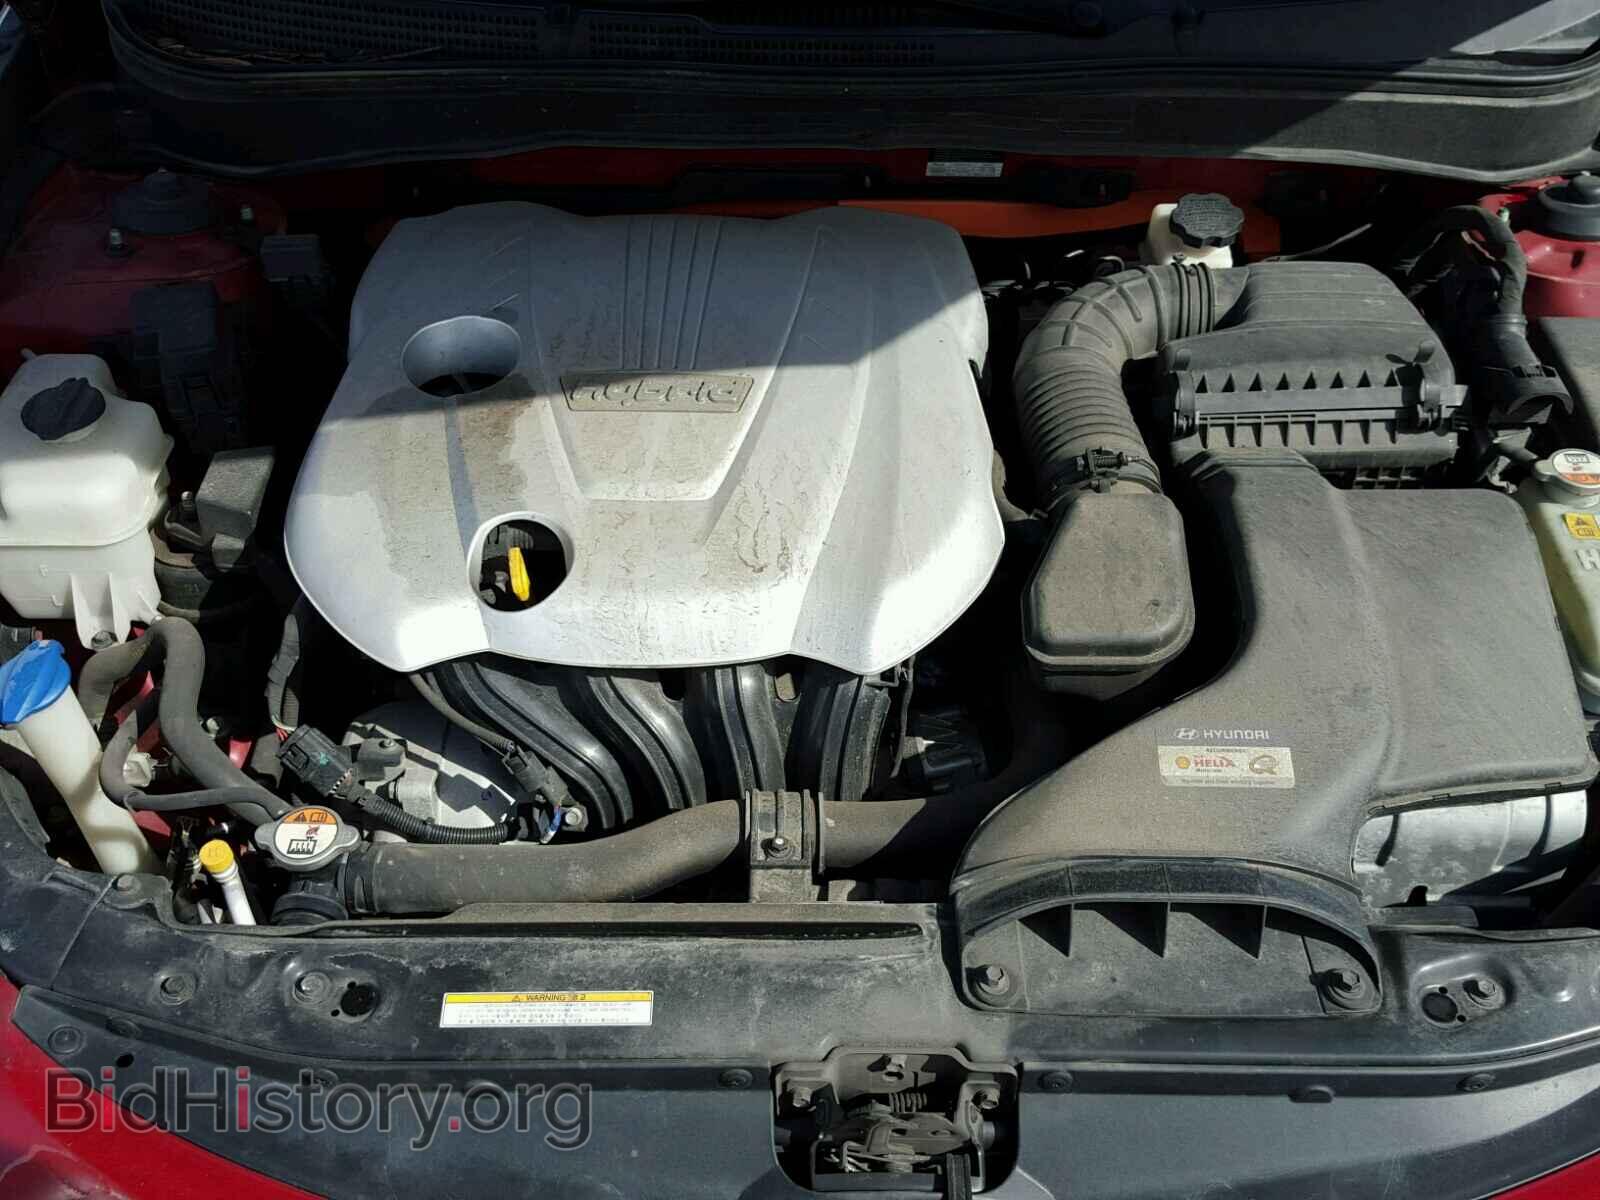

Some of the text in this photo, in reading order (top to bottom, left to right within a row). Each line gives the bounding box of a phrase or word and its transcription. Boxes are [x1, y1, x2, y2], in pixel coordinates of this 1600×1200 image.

[1203, 729, 1270, 740] HYUNDAI
[1194, 756, 1236, 768] HELIX
[526, 992, 568, 1001] WARNING
